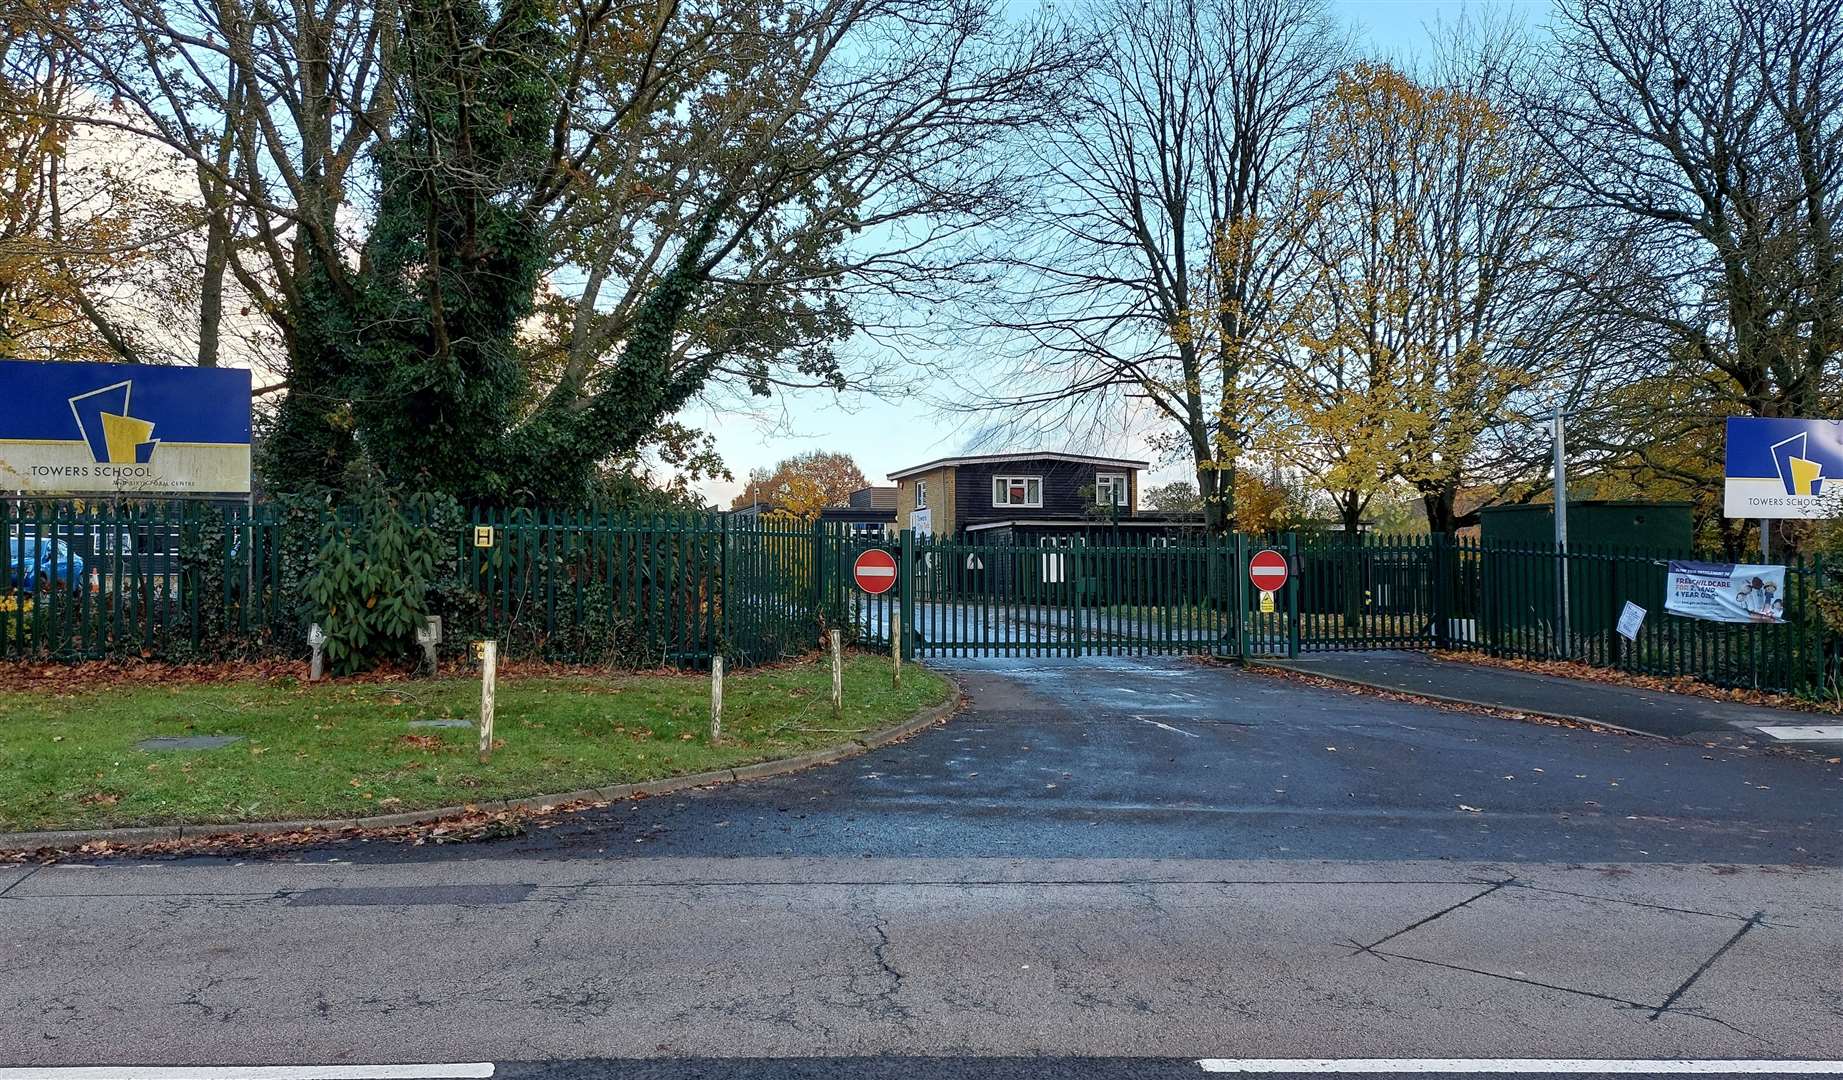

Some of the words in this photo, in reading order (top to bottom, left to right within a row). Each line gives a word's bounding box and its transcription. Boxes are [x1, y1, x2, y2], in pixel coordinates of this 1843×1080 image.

[31, 466, 89, 477] TOWERS
[94, 466, 152, 477] SCHOOL
[1748, 497, 1784, 506] TOWERS
[1786, 498, 1821, 506] SCHOO
[477, 529, 490, 545] H
[1691, 580, 1731, 588] CHILDCARE
